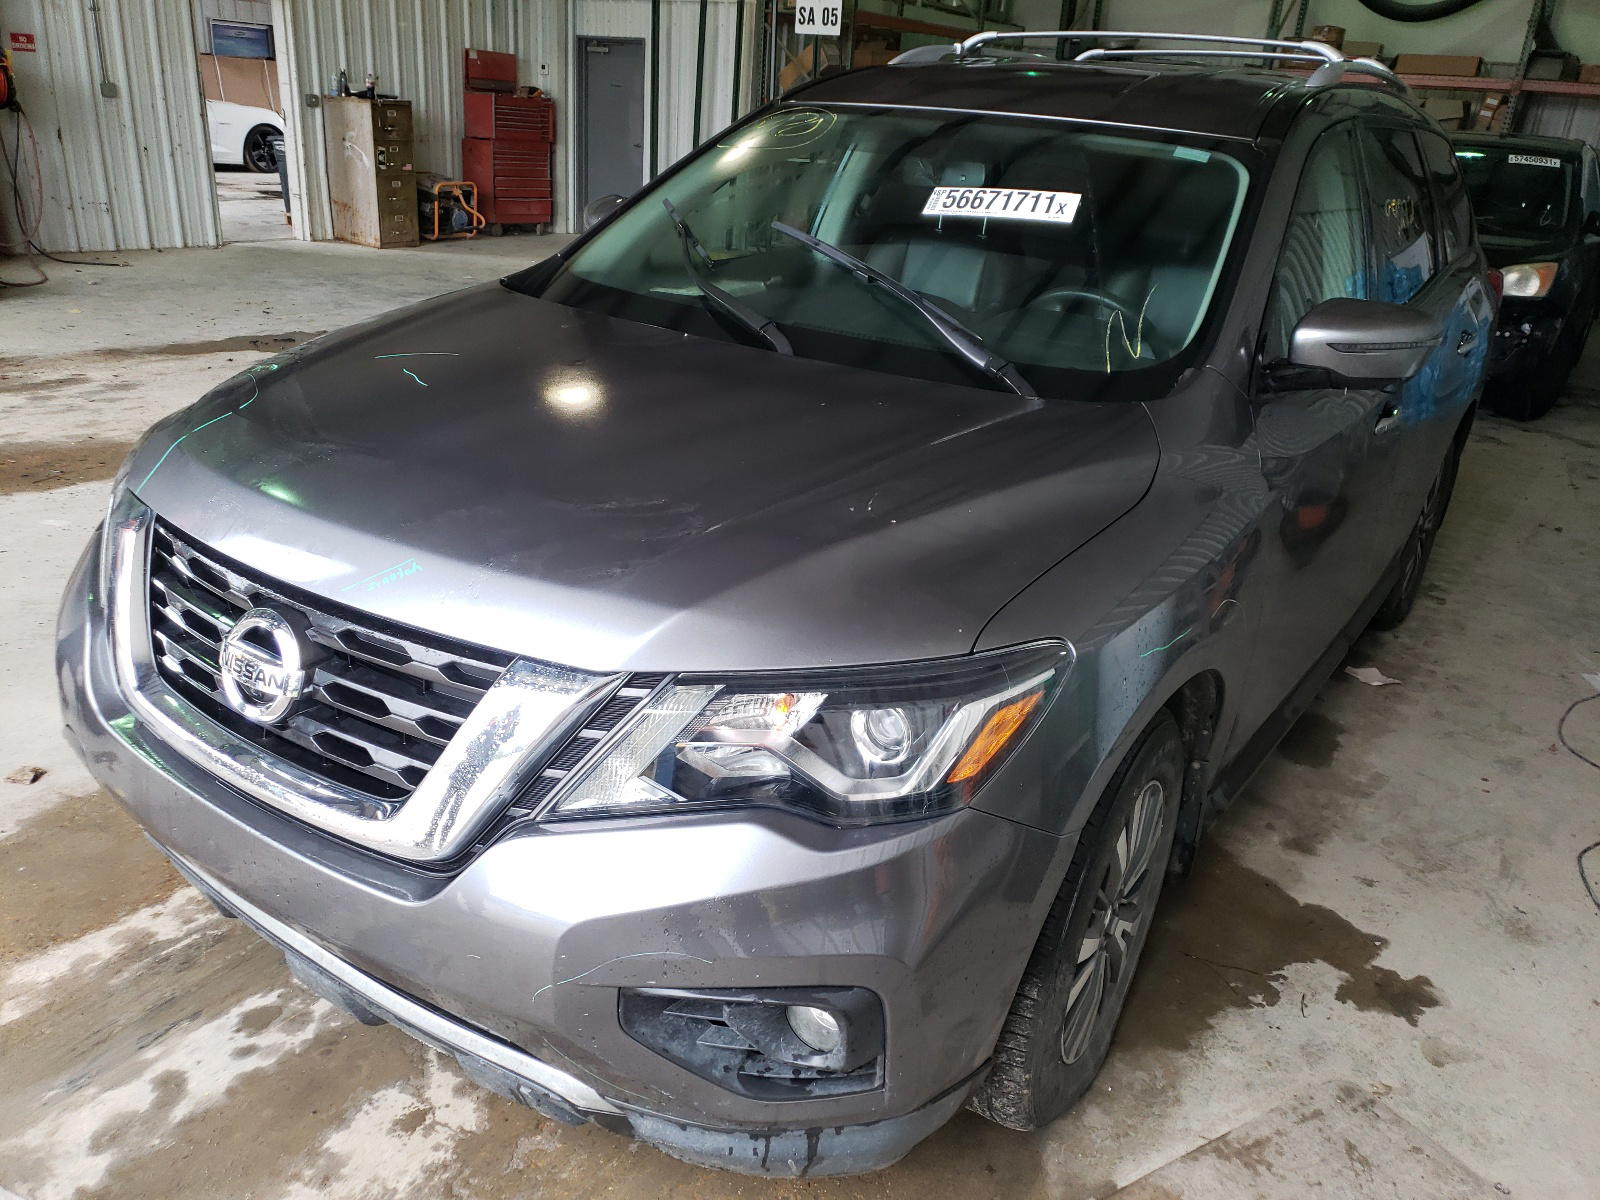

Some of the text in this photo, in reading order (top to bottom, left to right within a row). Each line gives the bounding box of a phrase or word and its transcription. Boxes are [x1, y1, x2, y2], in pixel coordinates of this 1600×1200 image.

[798, 6, 838, 26] SA 05
[222, 643, 291, 697] NISSAN
